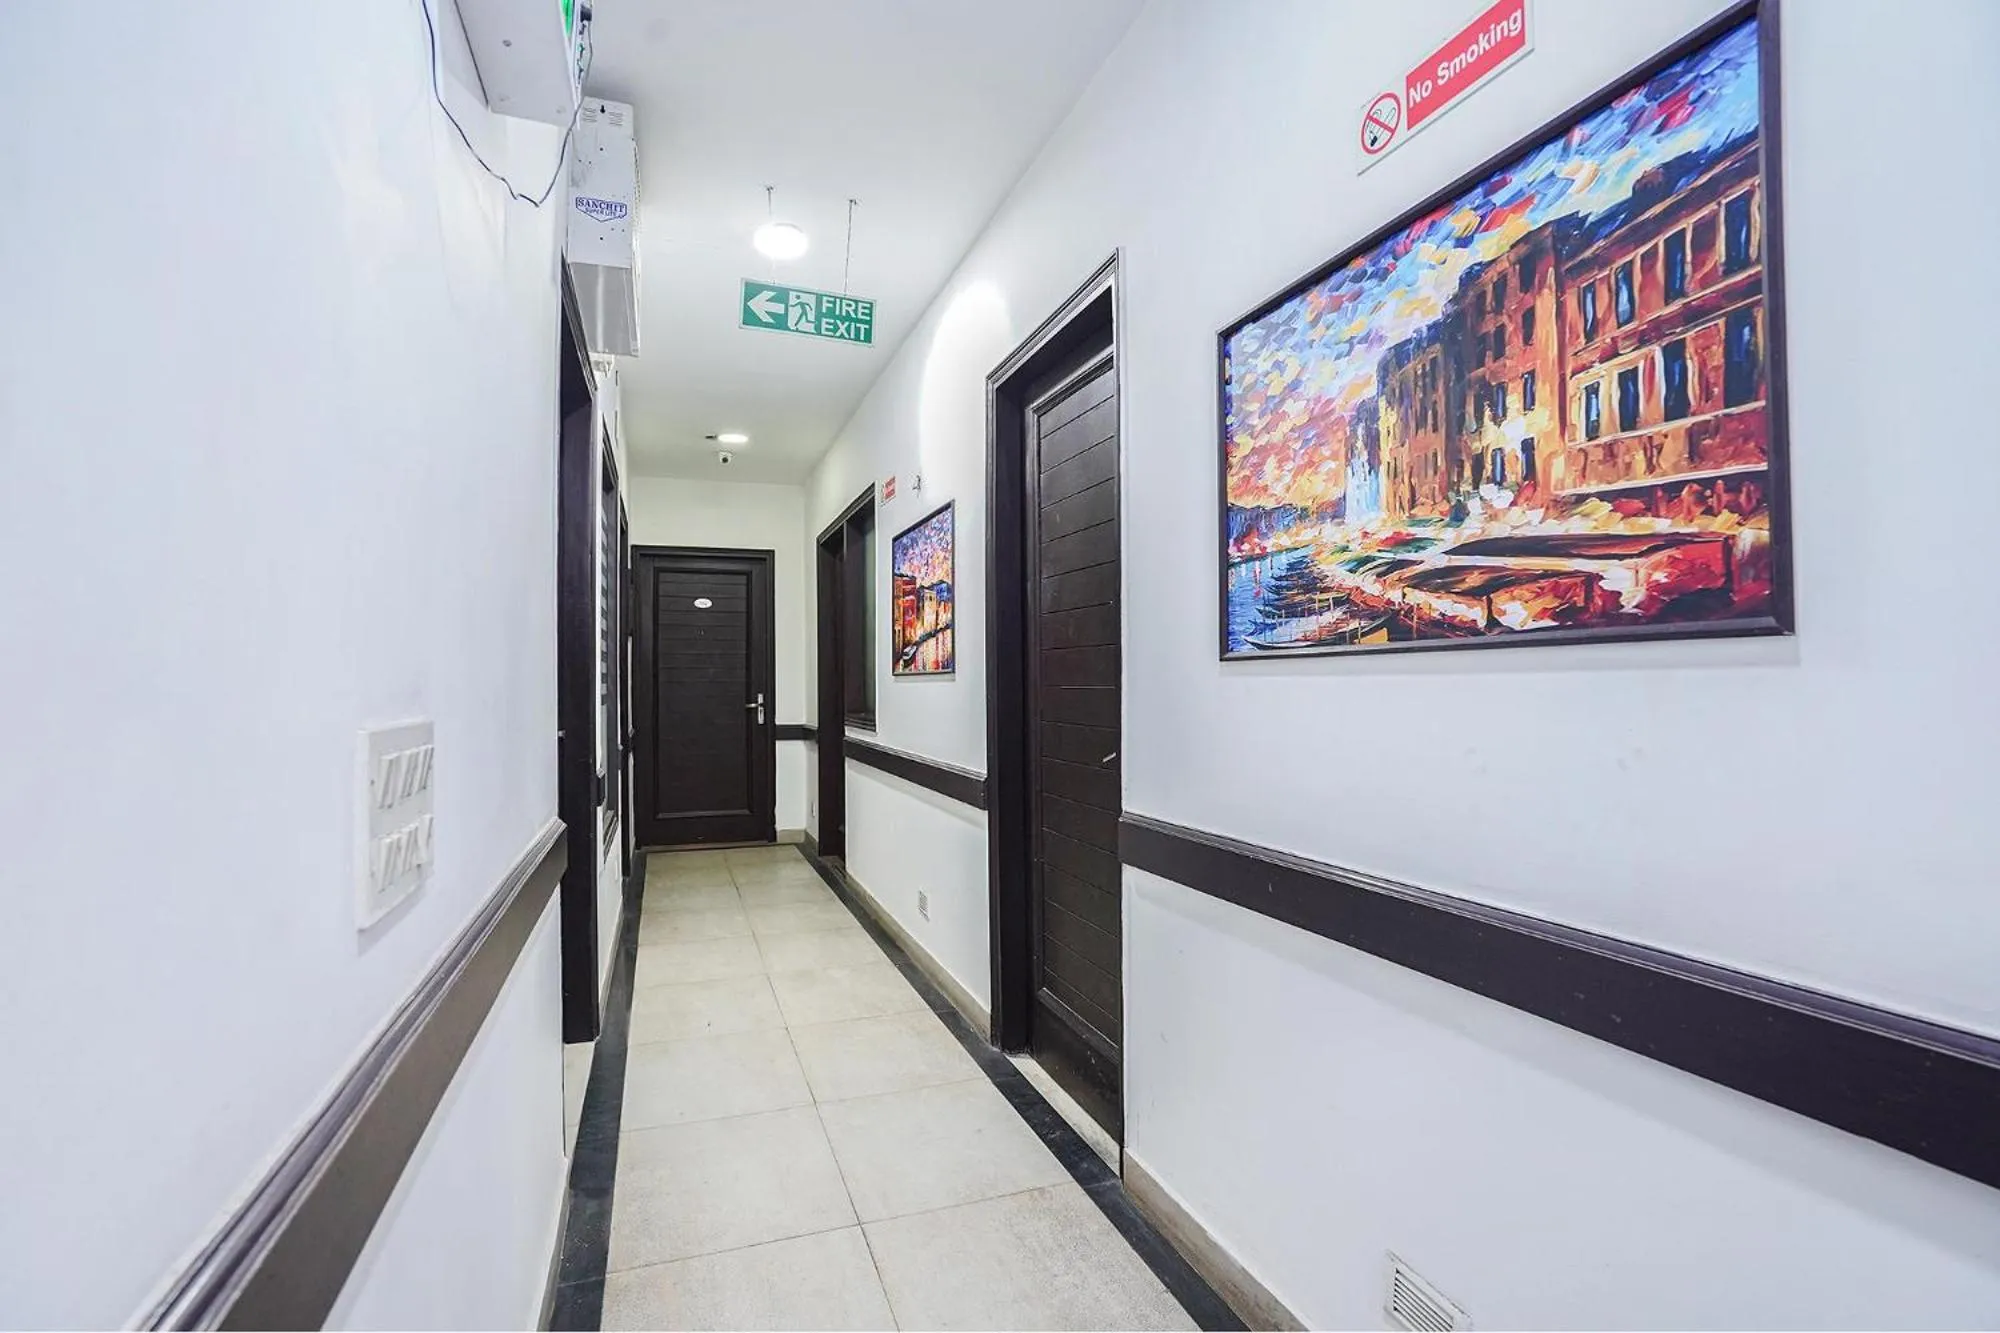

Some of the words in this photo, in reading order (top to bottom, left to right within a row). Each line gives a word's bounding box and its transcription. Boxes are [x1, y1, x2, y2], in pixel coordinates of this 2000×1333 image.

[1408, 79, 1433, 109] No
[1436, 8, 1522, 86] Smoking
[578, 199, 625, 213] SANCHIT
[822, 296, 870, 320] FIRE
[821, 318, 869, 341] EXIT
